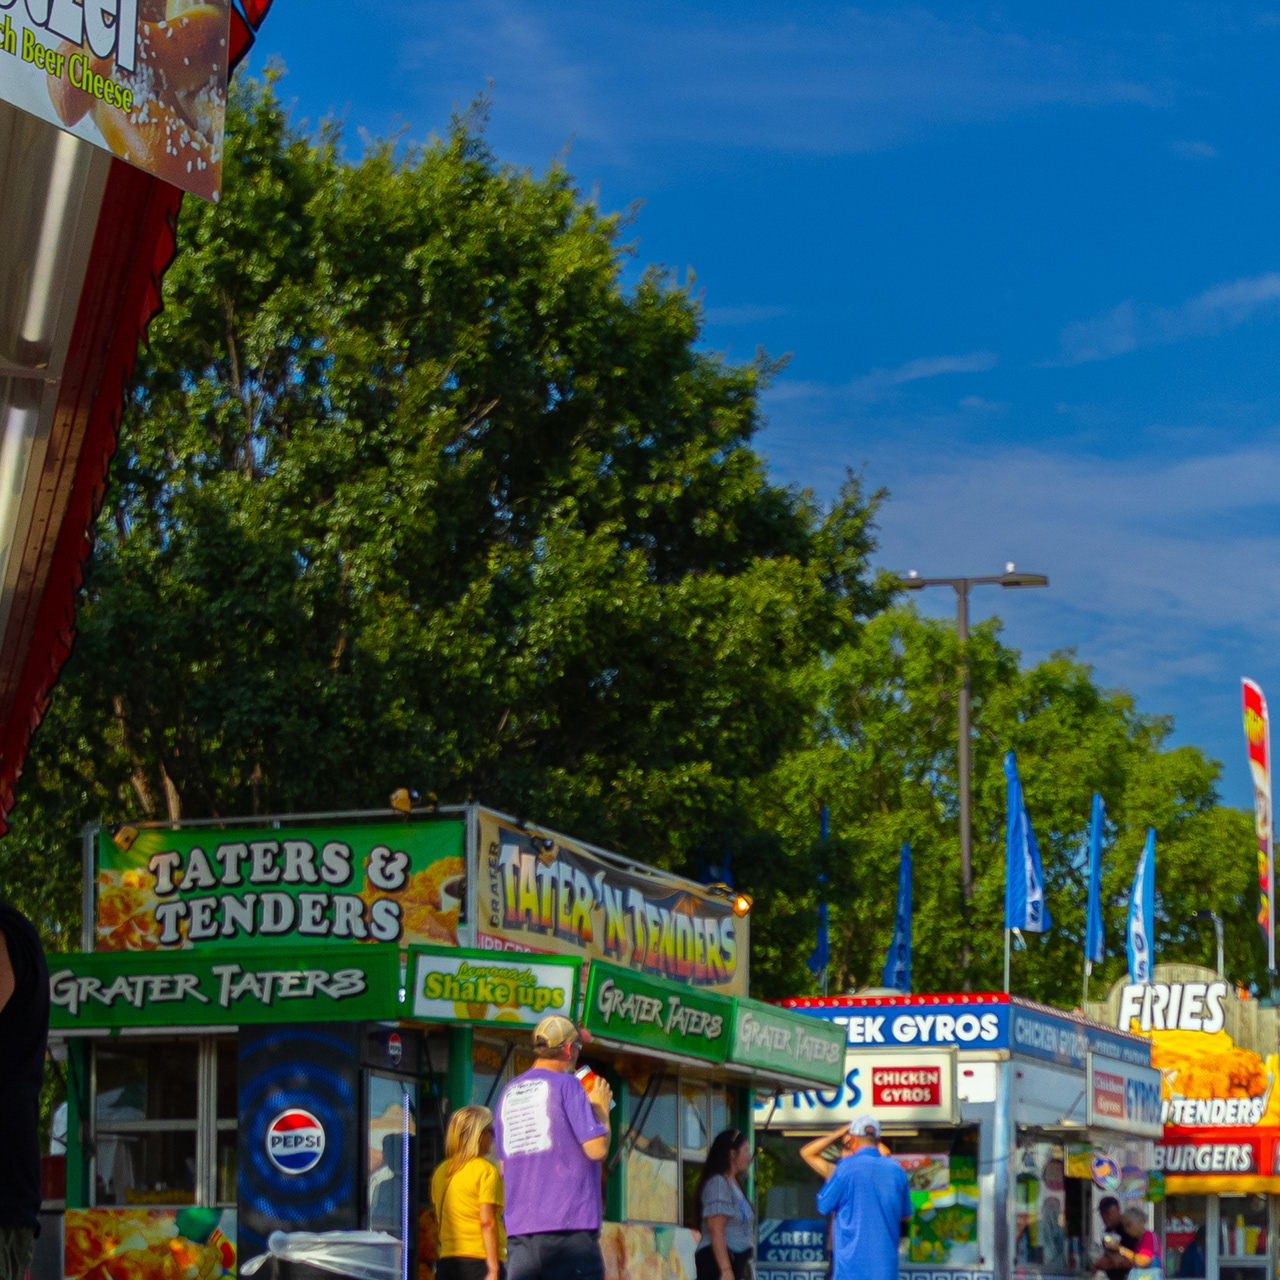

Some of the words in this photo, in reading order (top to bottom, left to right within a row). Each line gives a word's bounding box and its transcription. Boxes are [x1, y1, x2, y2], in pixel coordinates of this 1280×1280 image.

[21, 27, 65, 80] Beer
[69, 53, 133, 114] Cheese
[148, 840, 351, 895] TATERS
[367, 845, 410, 891] &
[155, 891, 401, 945] TENDERS
[498, 843, 594, 947] TATER
[626, 887, 738, 986] TENDERS
[49, 968, 210, 1017] GRATER
[211, 963, 367, 1010] TATERS
[424, 971, 511, 1004] Shake
[516, 984, 565, 1013] ups
[455, 961, 538, 986] Lemonade
[598, 978, 664, 1028] GRATER
[664, 995, 723, 1041] TATERS
[891, 1012, 1000, 1042] GYROS
[1118, 982, 1228, 1034] FRIES
[740, 1012, 793, 1055] GRATER
[793, 1026, 842, 1065] TATERS
[873, 1071, 938, 1087] CHICKEN
[880, 1087, 932, 1103] GYROS
[1173, 1097, 1264, 1127] TENDERS
[271, 1134, 321, 1149] PEPSI
[766, 1248, 824, 1262] GYROS
[770, 1230, 824, 1246] GREEK
